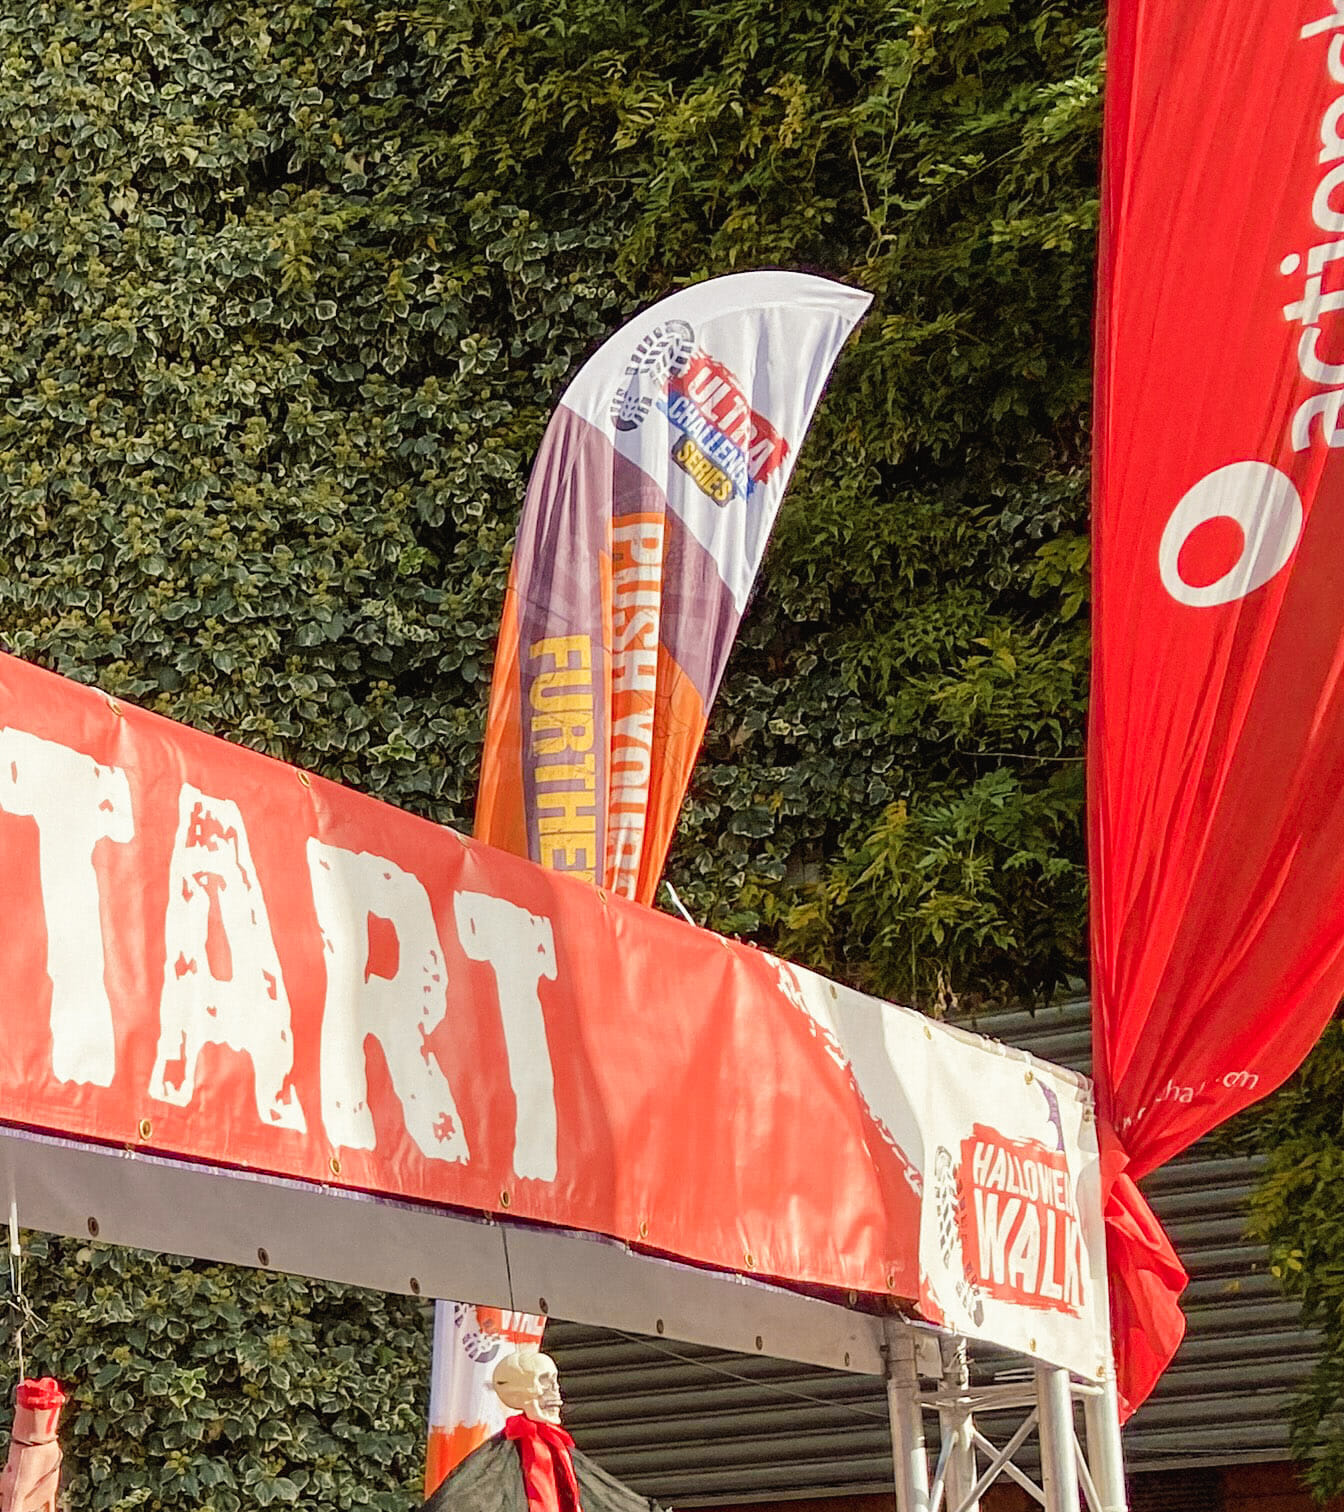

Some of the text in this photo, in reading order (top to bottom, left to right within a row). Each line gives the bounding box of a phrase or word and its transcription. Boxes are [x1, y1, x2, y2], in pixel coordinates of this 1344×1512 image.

[677, 440, 733, 502] SERIES
[687, 366, 775, 478] ULTRA
[613, 512, 666, 692] PUSH
[529, 634, 596, 888] FURTHE
[973, 1188, 1085, 1307] WALK
